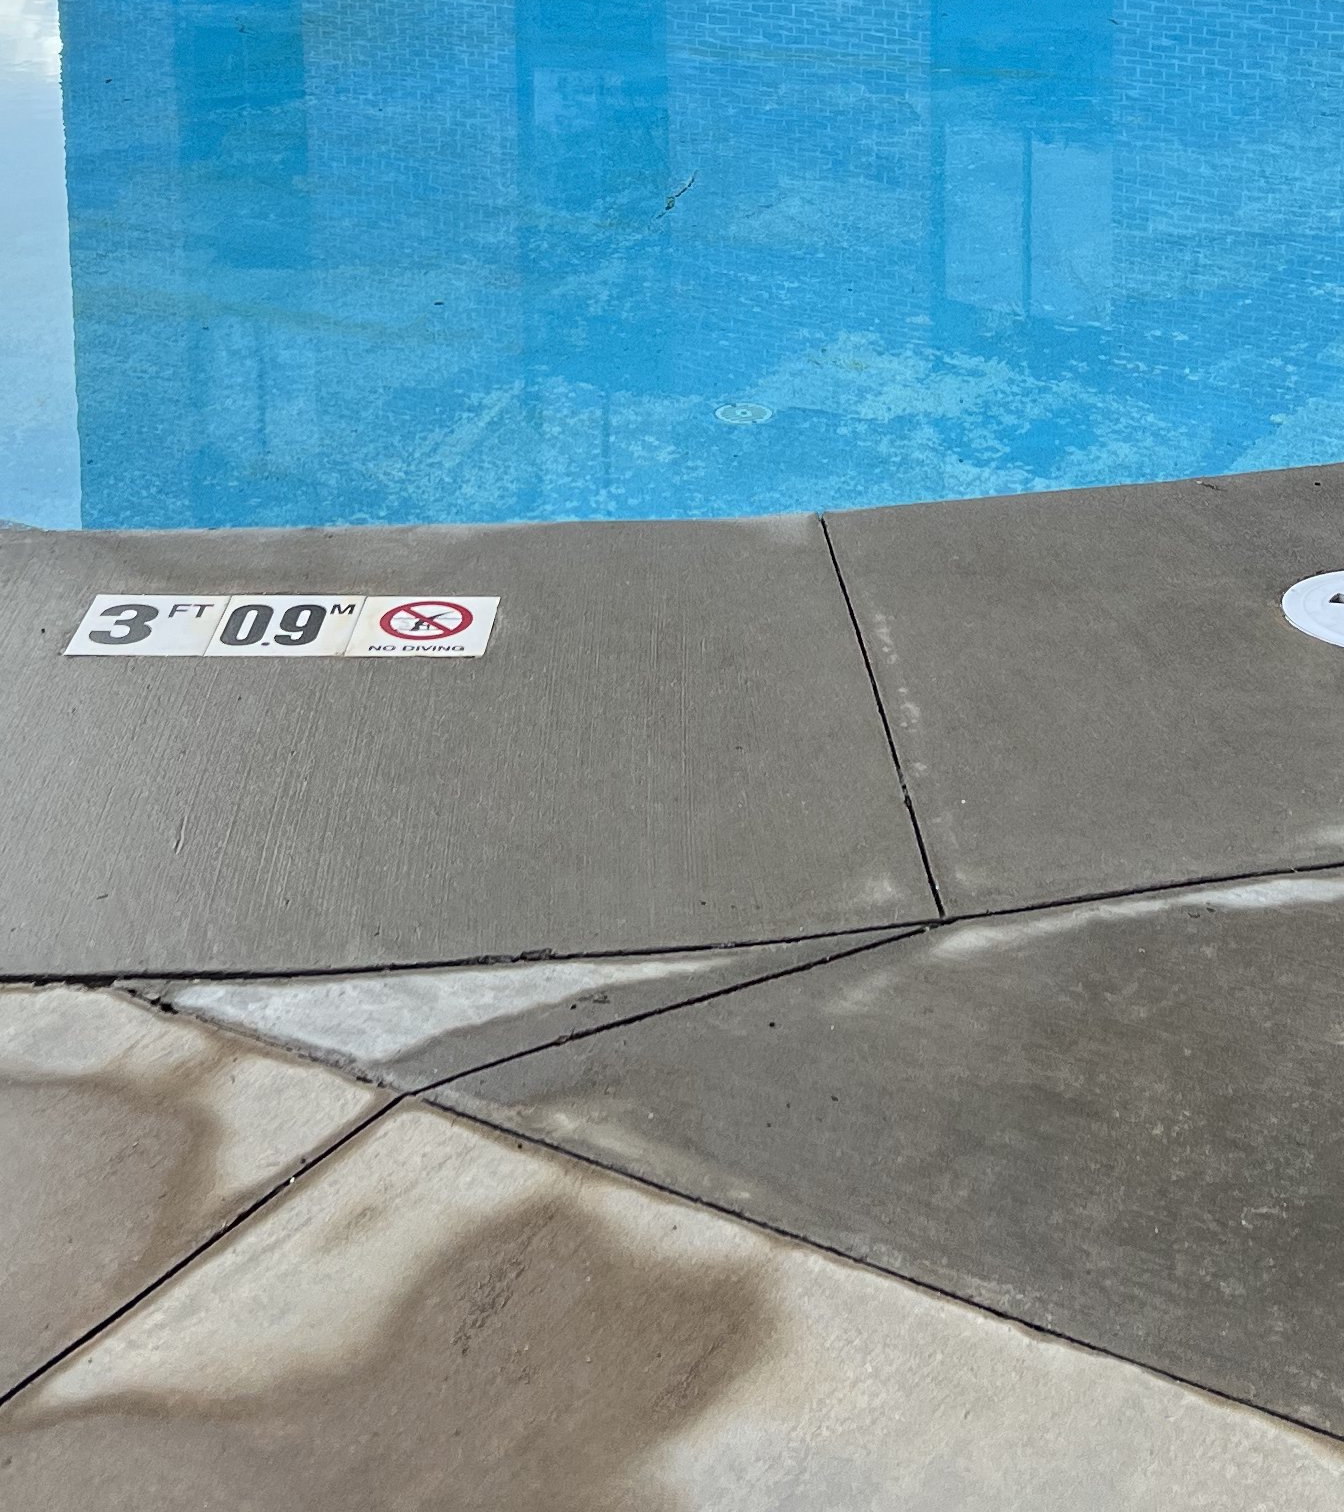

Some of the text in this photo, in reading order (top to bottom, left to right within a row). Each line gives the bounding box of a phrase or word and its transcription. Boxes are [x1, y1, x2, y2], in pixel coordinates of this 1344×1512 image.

[88, 603, 160, 645] 3
[167, 603, 215, 618] FT
[330, 603, 356, 615] M
